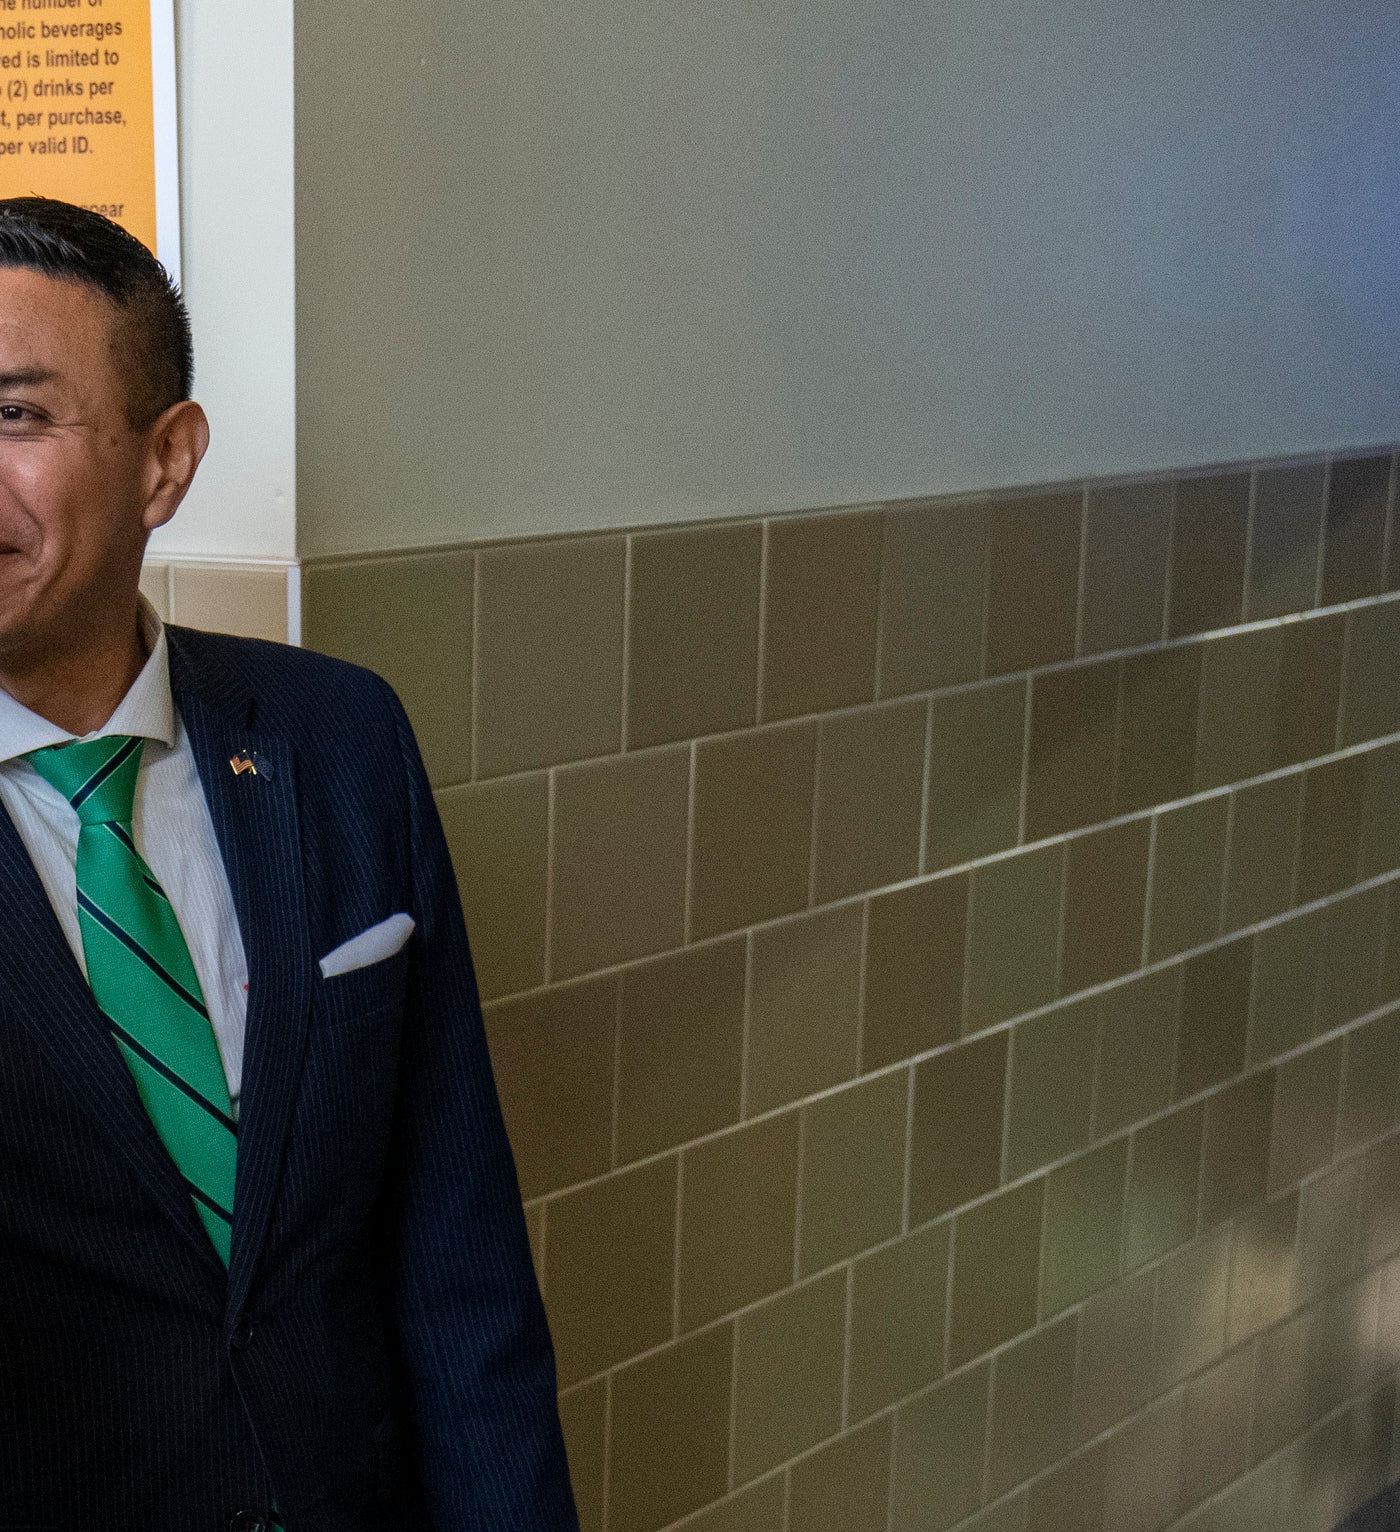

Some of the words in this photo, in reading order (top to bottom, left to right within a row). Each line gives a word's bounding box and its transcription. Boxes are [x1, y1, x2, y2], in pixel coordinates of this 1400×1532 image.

[41, 21, 123, 41] beverages
[27, 51, 40, 68] is
[46, 49, 99, 67] limited
[104, 50, 120, 66] to
[7, 80, 28, 101] (2)
[33, 79, 83, 97] drinks
[89, 81, 115, 100] per
[17, 112, 43, 130] per
[48, 107, 126, 129] purchase,
[28, 136, 67, 155] valid
[72, 136, 93, 154] ID.
